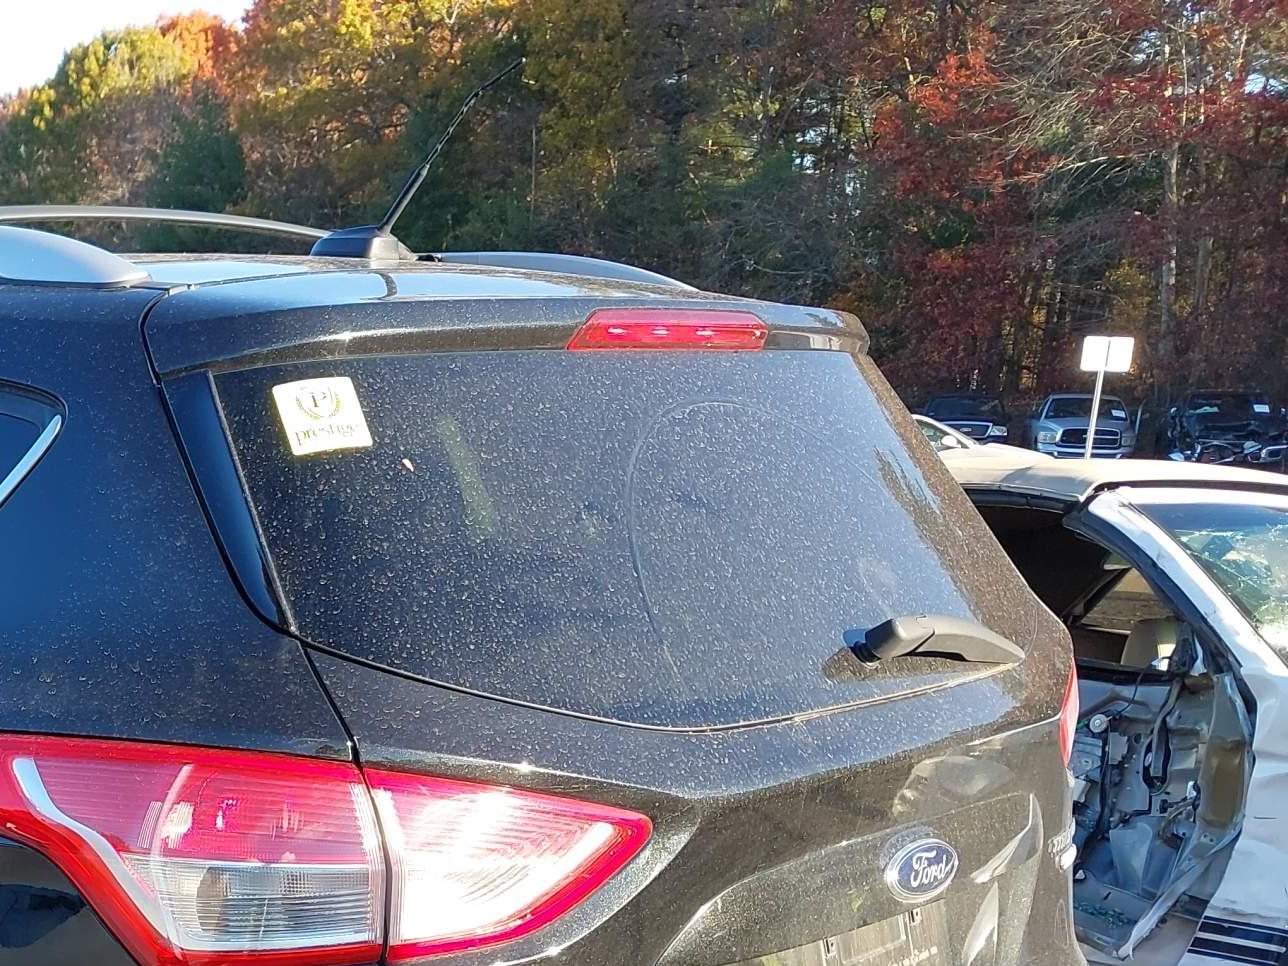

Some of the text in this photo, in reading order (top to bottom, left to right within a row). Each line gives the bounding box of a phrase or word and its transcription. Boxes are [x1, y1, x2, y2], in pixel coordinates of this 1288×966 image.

[309, 391, 327, 408] P
[295, 423, 360, 447] prestige
[910, 850, 952, 888] Ford
